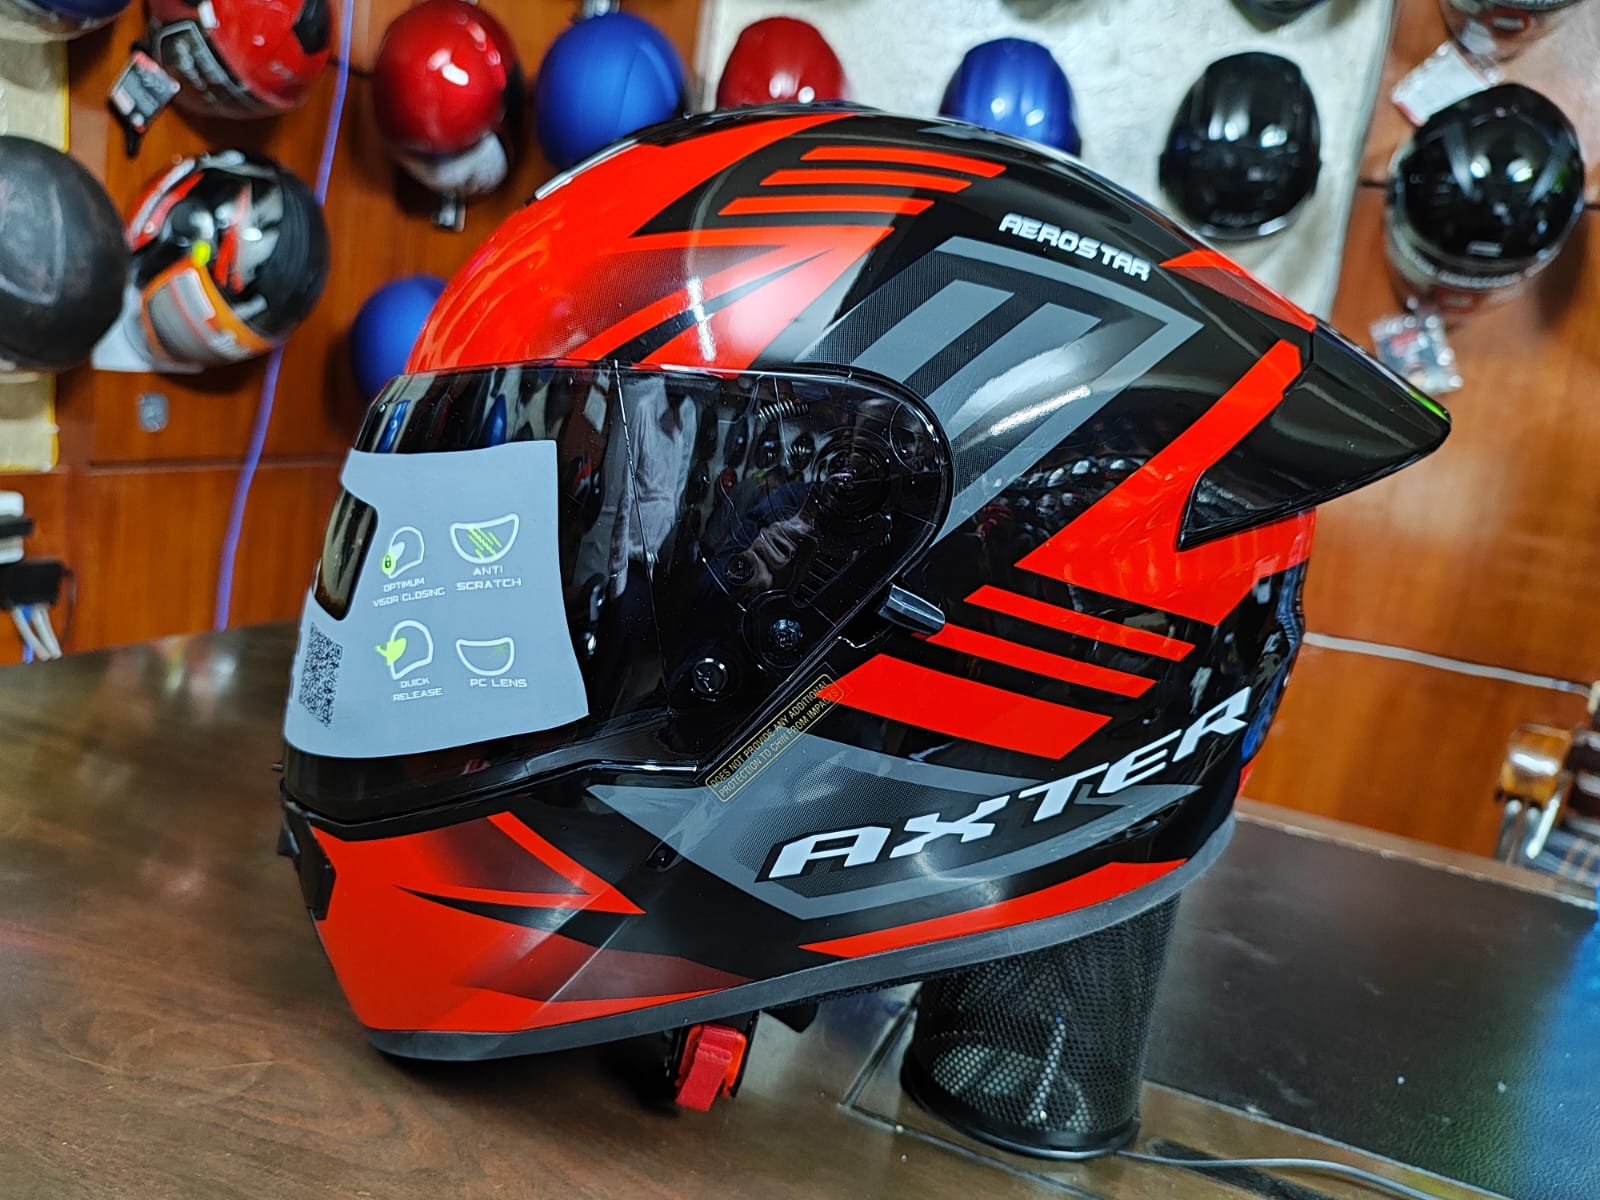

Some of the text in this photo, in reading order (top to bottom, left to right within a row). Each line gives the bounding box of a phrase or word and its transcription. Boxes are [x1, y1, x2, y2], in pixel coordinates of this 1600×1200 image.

[998, 212, 1151, 282] AEROSTAR
[472, 565, 504, 576] ANTI
[383, 577, 425, 593] OPTIMUM
[455, 577, 522, 591] SCRATCH
[373, 587, 446, 608] VISOR CLOSING
[400, 677, 431, 689] QUICK
[470, 678, 528, 688] PC LENS
[392, 688, 444, 702] RELEASE
[710, 680, 829, 788] DOES NOT PROVIDE ANY ADDITIONAL
[719, 688, 839, 797] PROTECTION TO CHIN FROM IMPACTS
[767, 686, 1252, 879] AXTER
